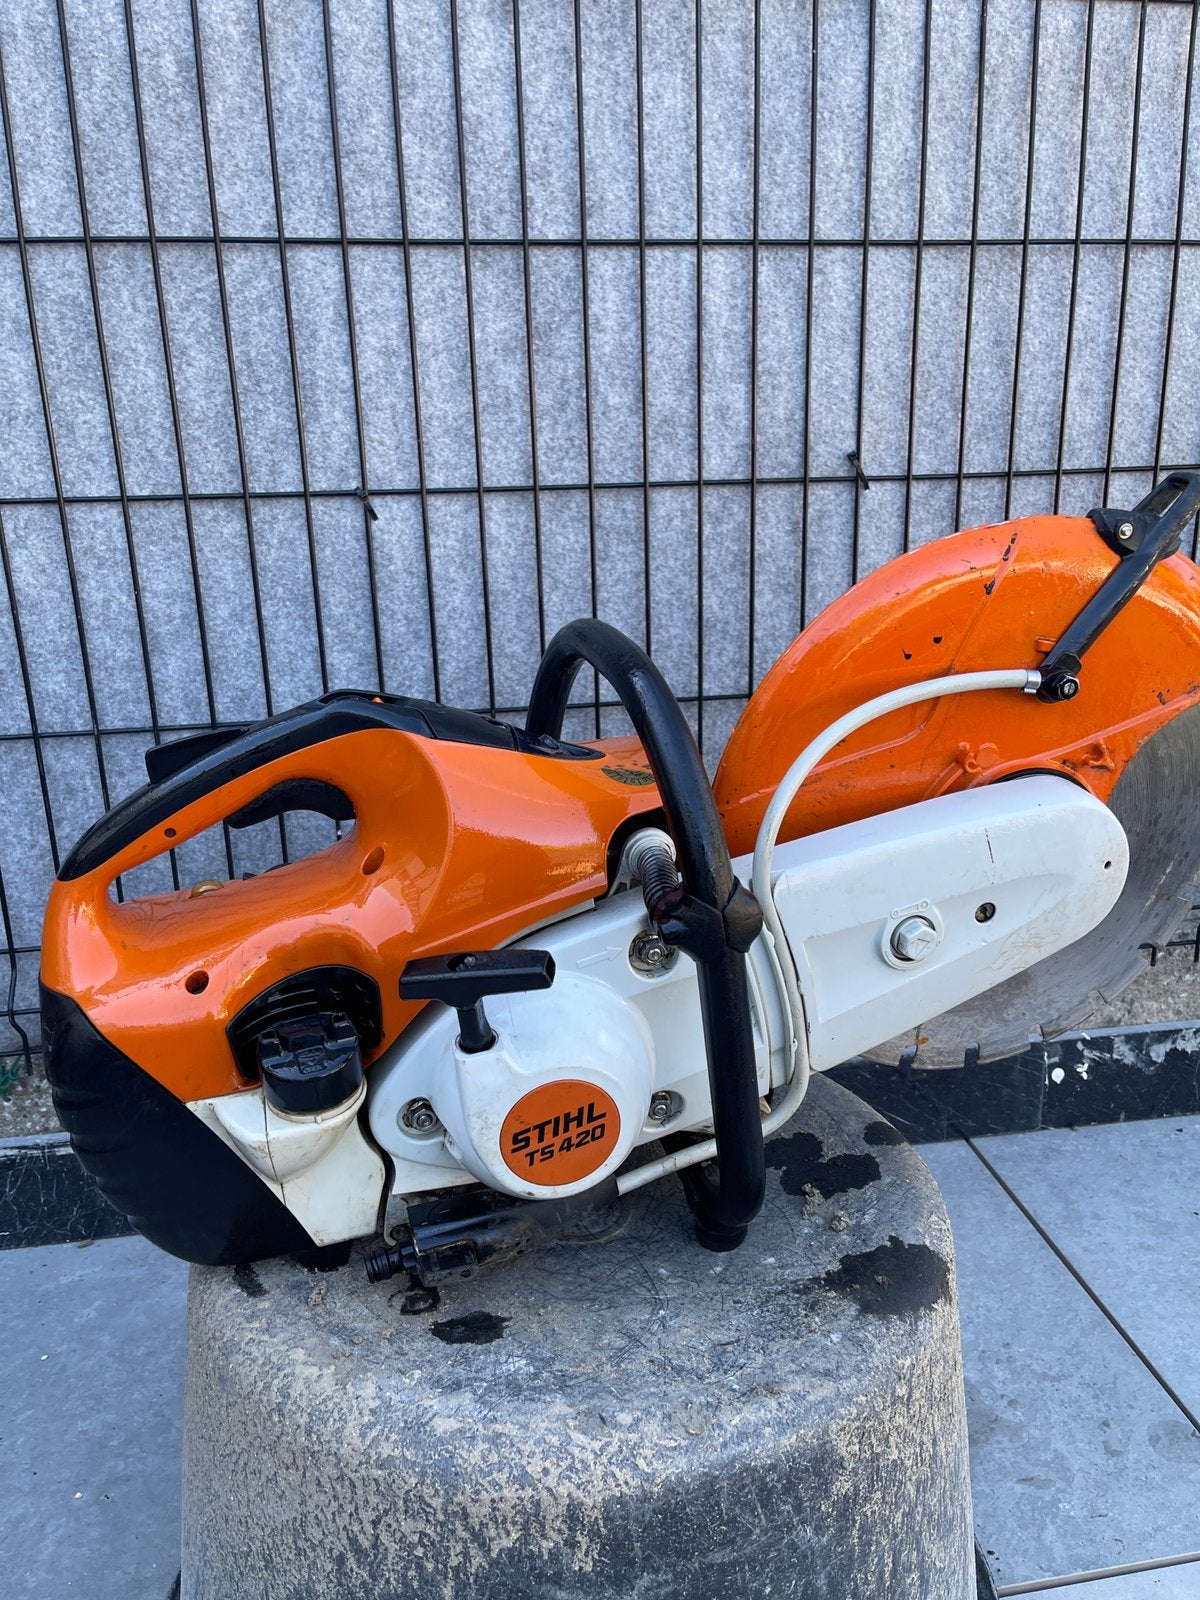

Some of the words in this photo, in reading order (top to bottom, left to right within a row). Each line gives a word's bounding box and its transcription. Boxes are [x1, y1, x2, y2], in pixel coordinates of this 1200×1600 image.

[511, 1102, 607, 1154] STIHL
[525, 1143, 555, 1167] TS
[558, 1123, 606, 1153] 420
